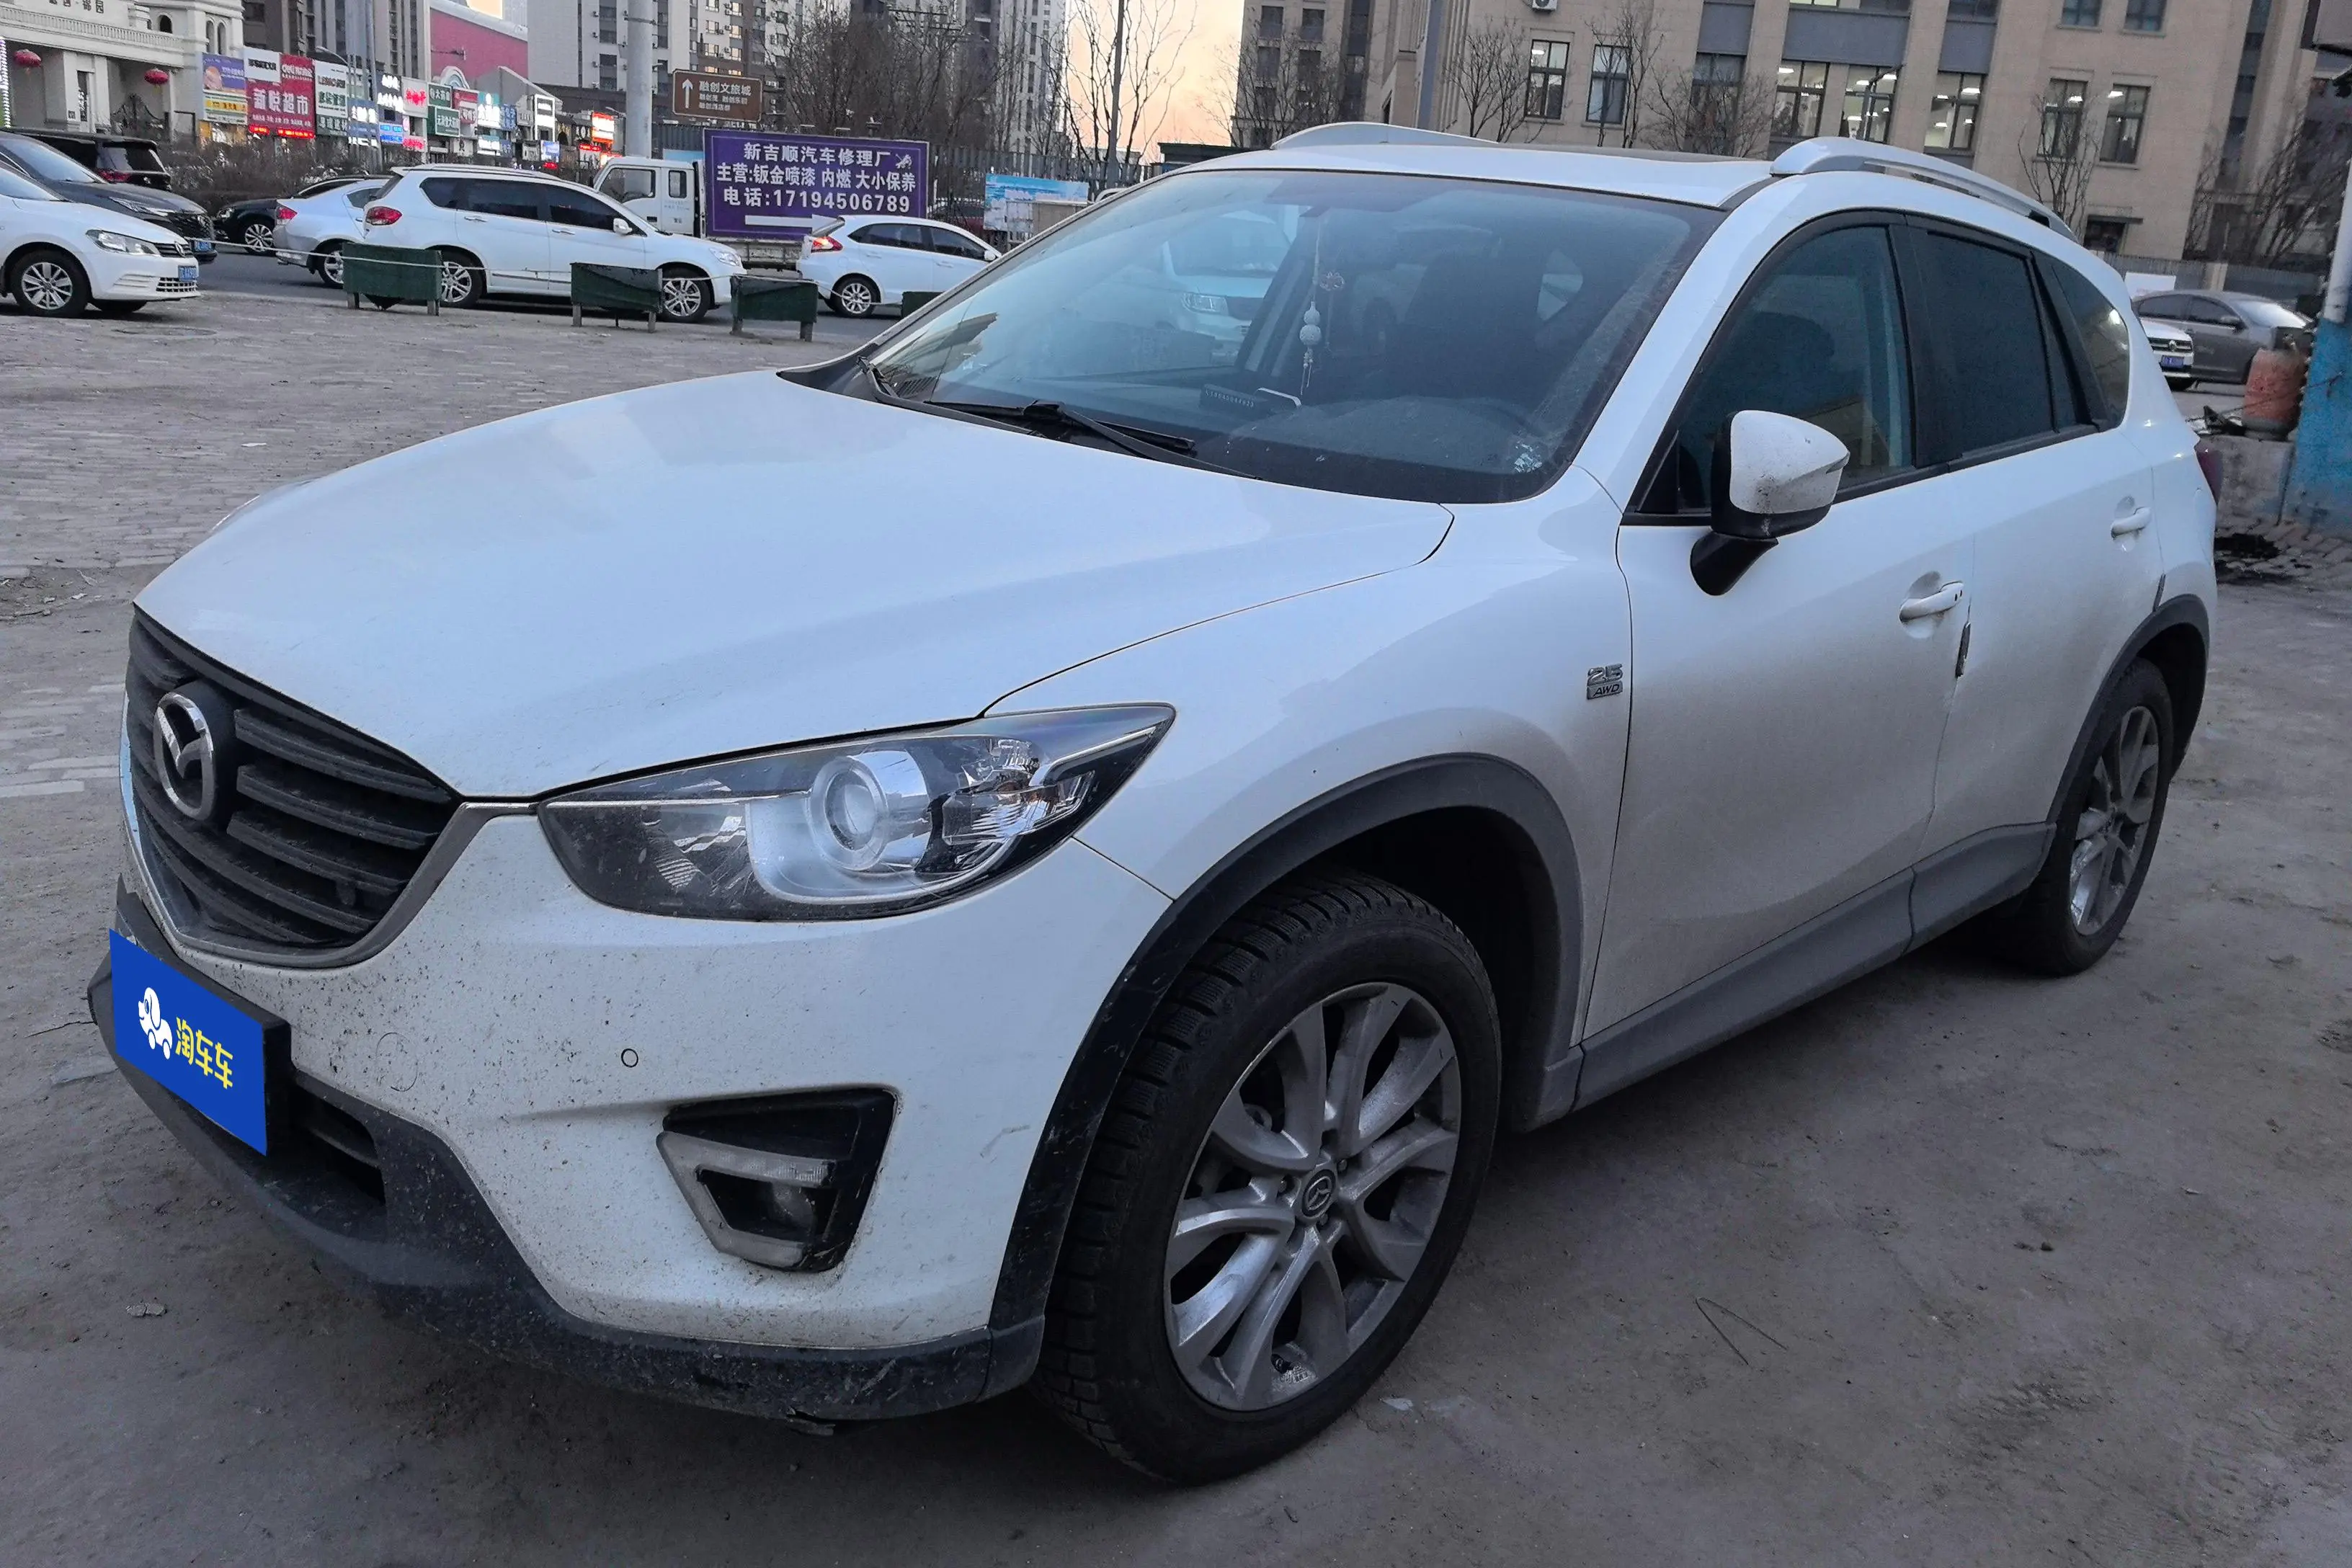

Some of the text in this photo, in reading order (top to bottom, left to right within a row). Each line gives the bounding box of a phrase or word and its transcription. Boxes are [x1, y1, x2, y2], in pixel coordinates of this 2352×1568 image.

[744, 142, 891, 167] 新吉顺汽车修理厂
[716, 162, 917, 193] 主营:钣金喷漆 内燃 大小保养
[723, 187, 910, 213] 电话:17194506789
[1592, 684, 1619, 697] AWD
